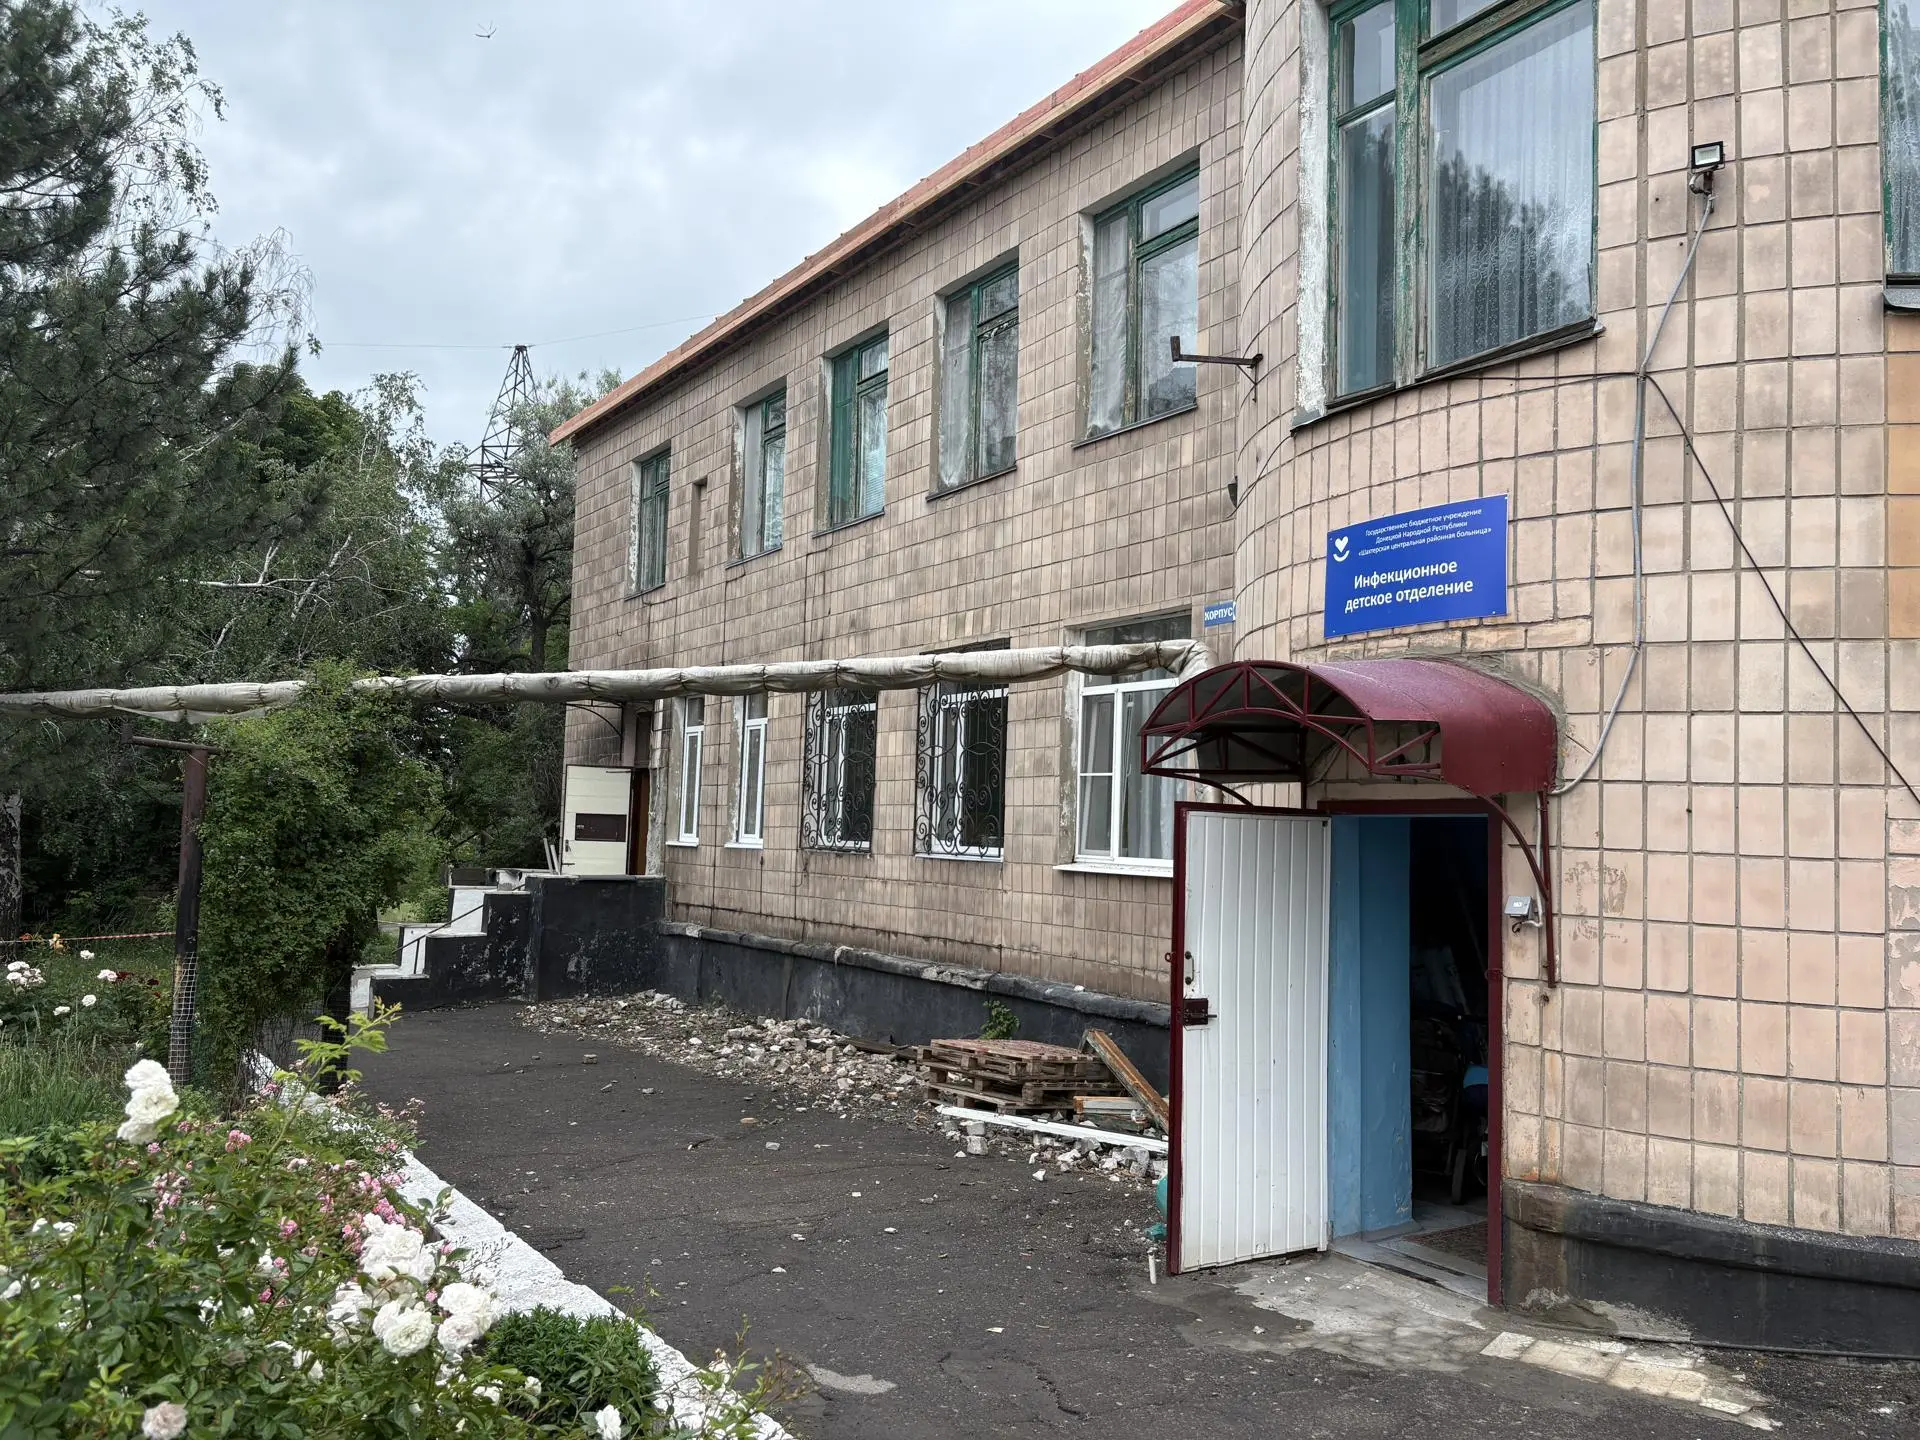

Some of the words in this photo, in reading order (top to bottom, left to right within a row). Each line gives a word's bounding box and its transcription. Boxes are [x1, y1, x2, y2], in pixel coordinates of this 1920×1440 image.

[1365, 522, 1408, 536] Государственное
[1409, 515, 1442, 527] бюджетное
[1443, 509, 1482, 521] учреждение
[1375, 532, 1401, 544] Донецкой
[1402, 525, 1431, 538] Народной
[1431, 521, 1468, 532] Республики
[1390, 538, 1425, 549] центральная
[1426, 533, 1456, 545] районная
[1456, 528, 1492, 538] больница»
[1354, 561, 1458, 589] Инфекционное
[1344, 592, 1393, 614] детское
[1395, 580, 1474, 603] отделение
[1204, 607, 1233, 621] КОРПУС
